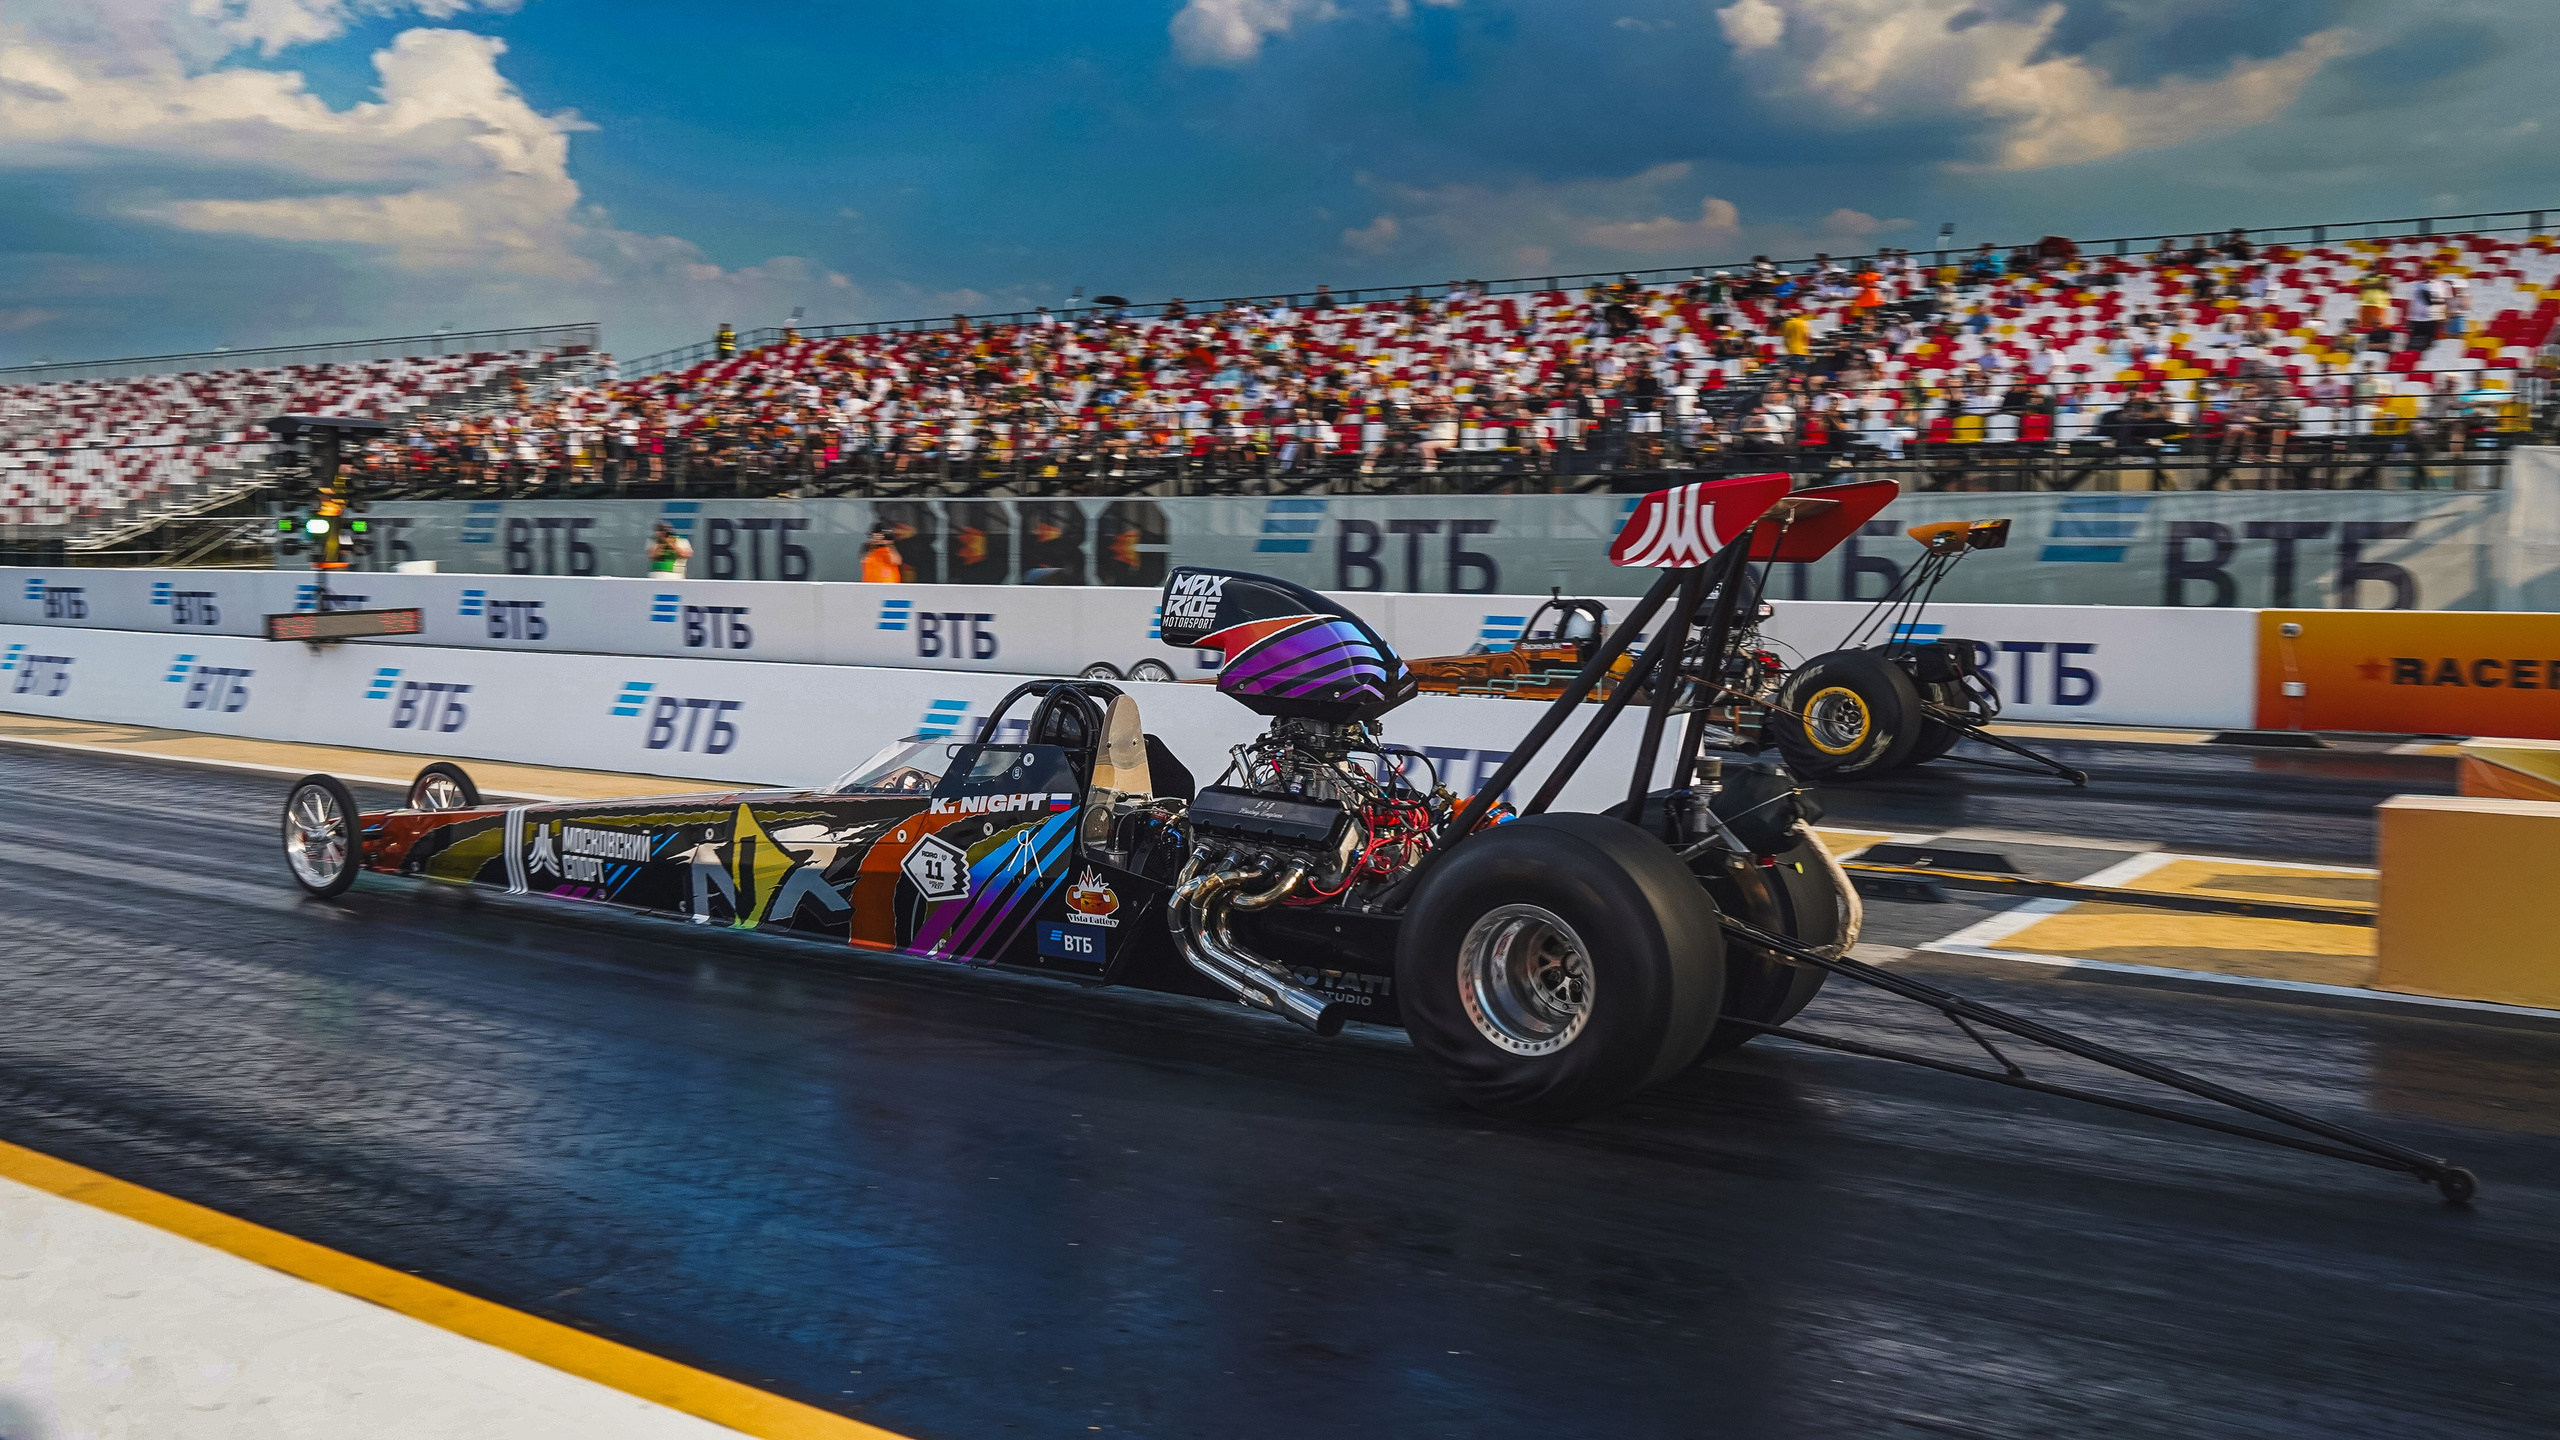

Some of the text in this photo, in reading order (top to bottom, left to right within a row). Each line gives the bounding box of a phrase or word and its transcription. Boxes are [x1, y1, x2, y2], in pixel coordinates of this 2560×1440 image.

[504, 517, 597, 575] ВТБ
[706, 517, 816, 581] ВТБ
[1332, 518, 1502, 595] ВТБ
[2164, 520, 2421, 609] ВТБ
[43, 586, 89, 620] ВТБ
[1170, 574, 1231, 597] MAX
[171, 590, 222, 626] ВТБ
[486, 600, 548, 641] ВТБ
[1162, 616, 1215, 629] MOTORSPORT
[682, 605, 755, 650] ВТБ
[915, 611, 1000, 661] ВТБ
[12, 654, 76, 697] ВТБ
[183, 665, 256, 713] ВТБ
[391, 680, 475, 733] ВТБ
[645, 695, 744, 755] ВТБ
[960, 793, 1048, 814] NIGHT
[562, 826, 651, 862] МОСКОВСКИЙ
[562, 854, 605, 883] СПОРТ
[925, 860, 945, 881] 11
[1068, 914, 1119, 926] Vista Battery
[1064, 934, 1093, 954] ВТБ
[1317, 990, 1372, 1006] TUDIO
